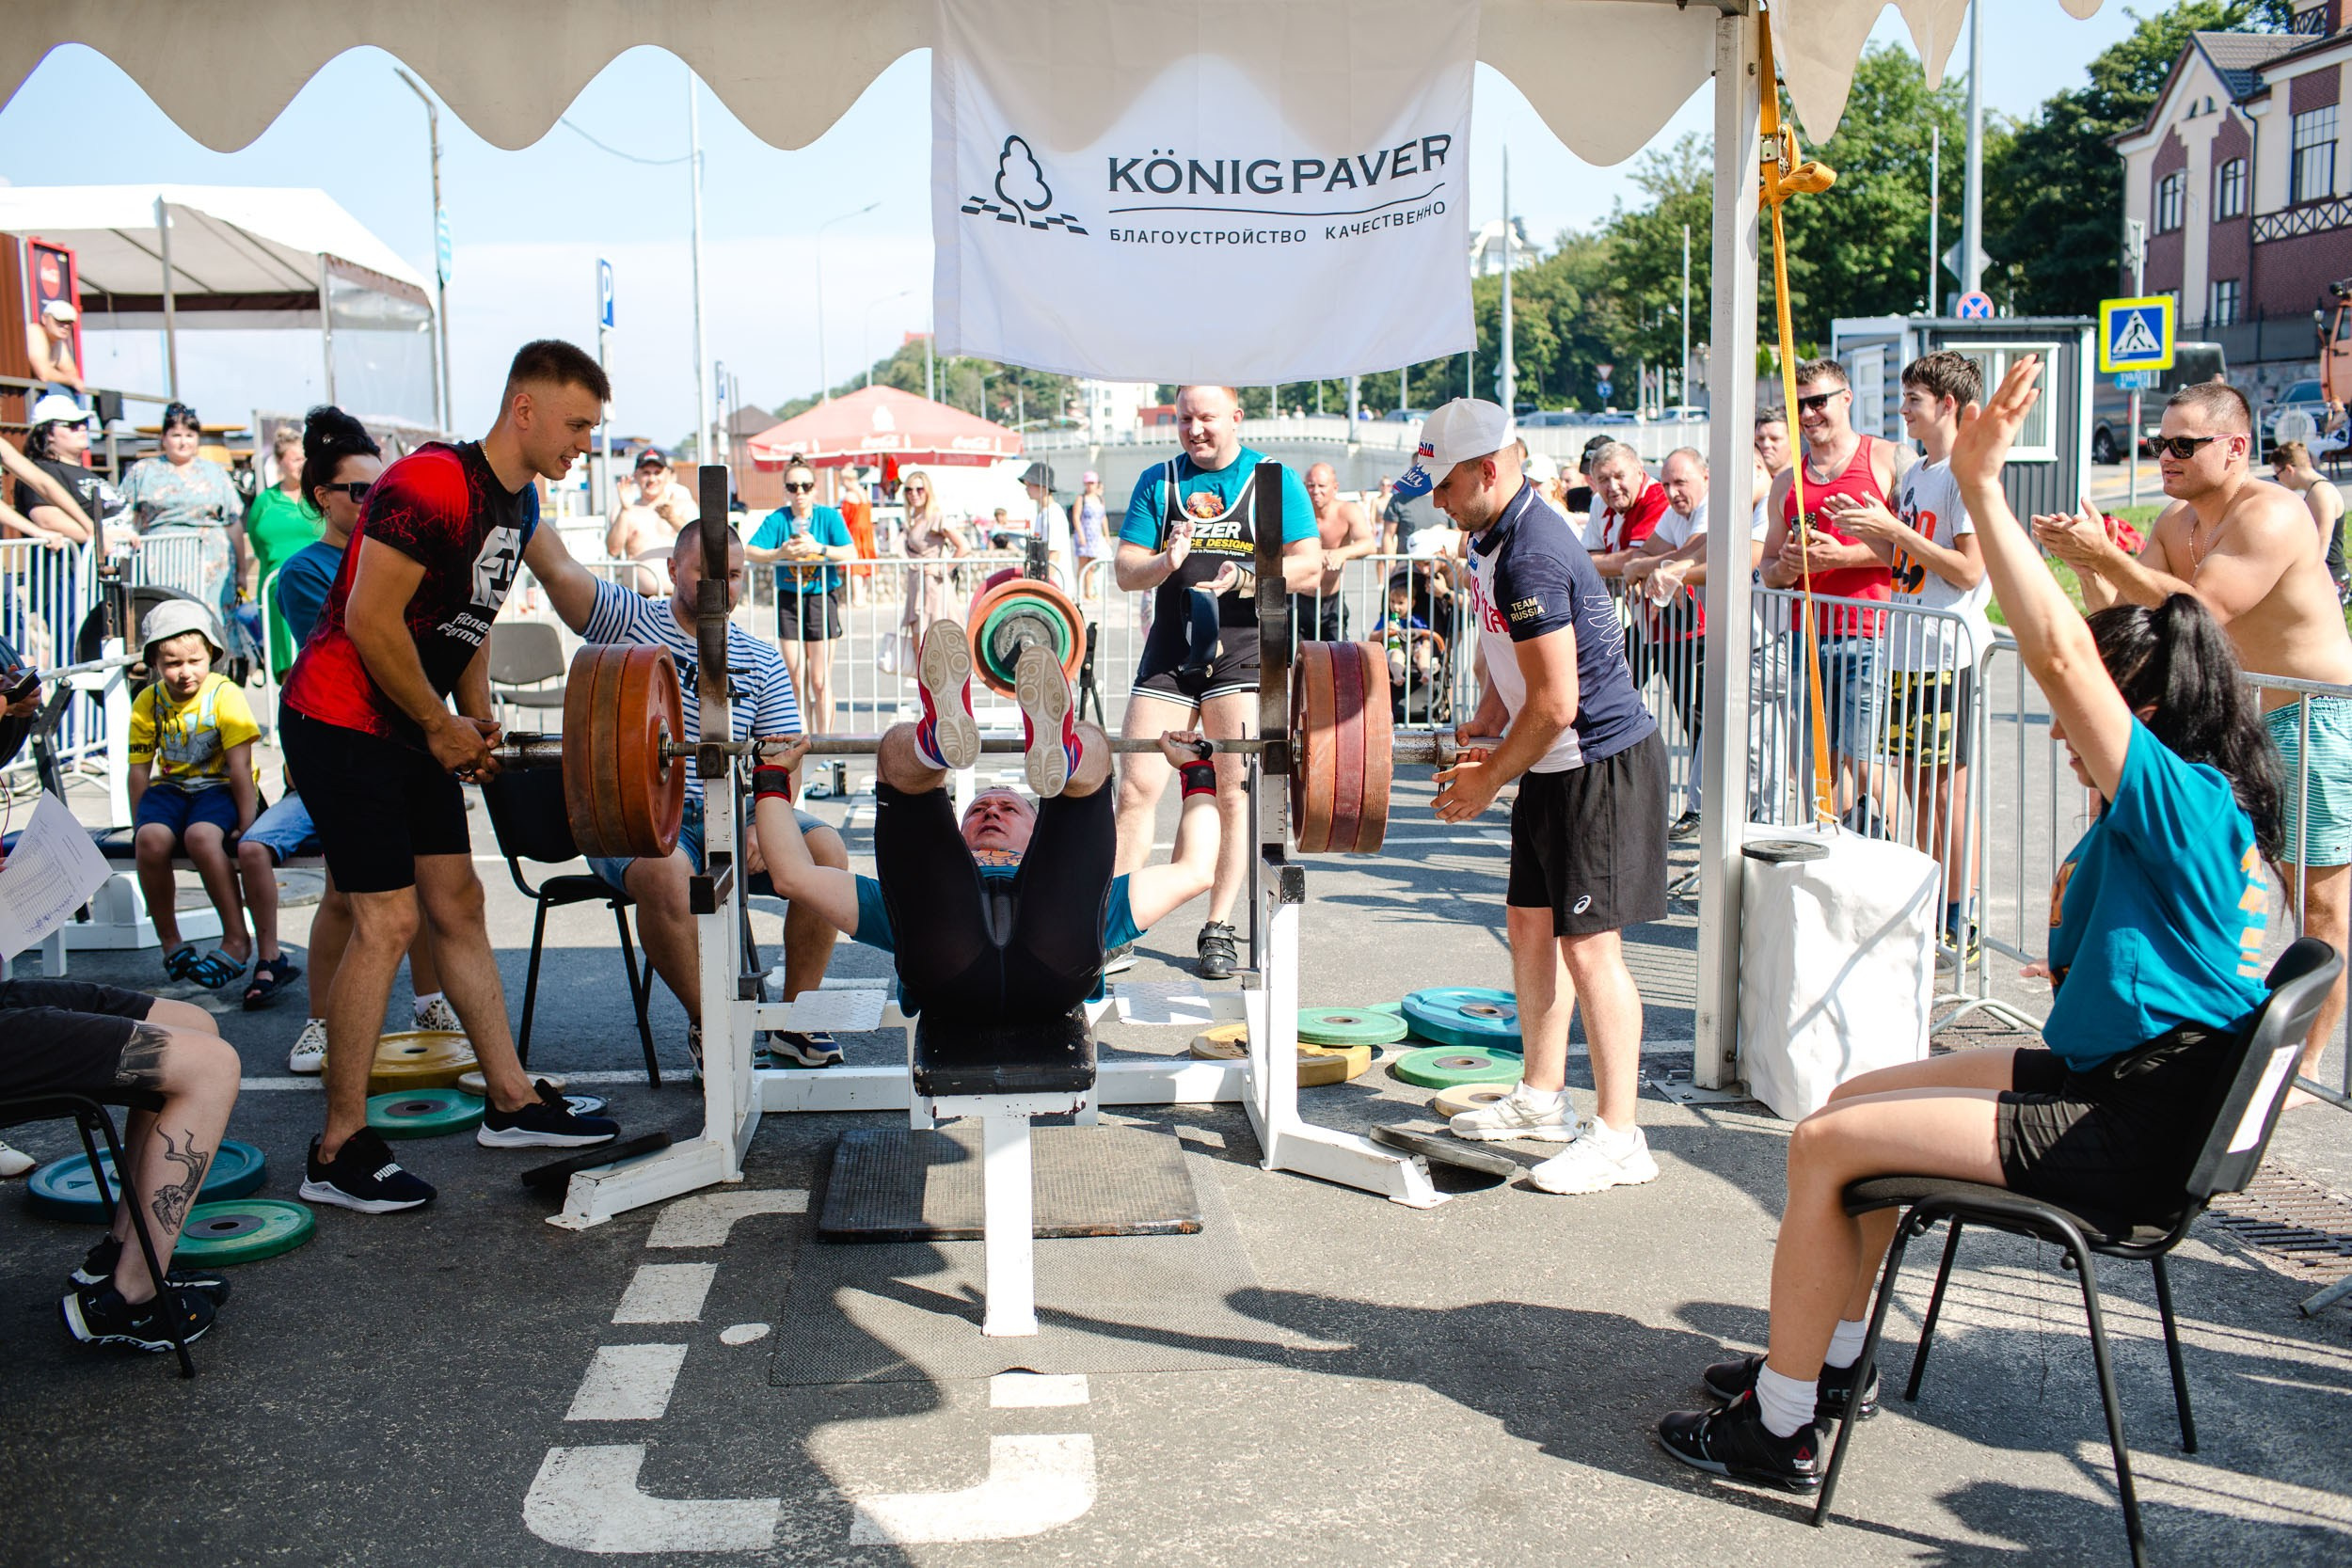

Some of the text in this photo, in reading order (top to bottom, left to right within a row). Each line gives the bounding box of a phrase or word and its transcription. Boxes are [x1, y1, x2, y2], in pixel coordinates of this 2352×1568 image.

[1108, 134, 1452, 194] KÖNIGPAVER
[1110, 201, 1446, 245] БЛАГОУСТРОЙСТВО КАЧЕСТВЕННО
[1206, 538, 1254, 553] DESIGNS
[1511, 596, 1537, 611] TEAM
[452, 612, 489, 634] Fitne
[1510, 605, 1546, 622] RUSSIA
